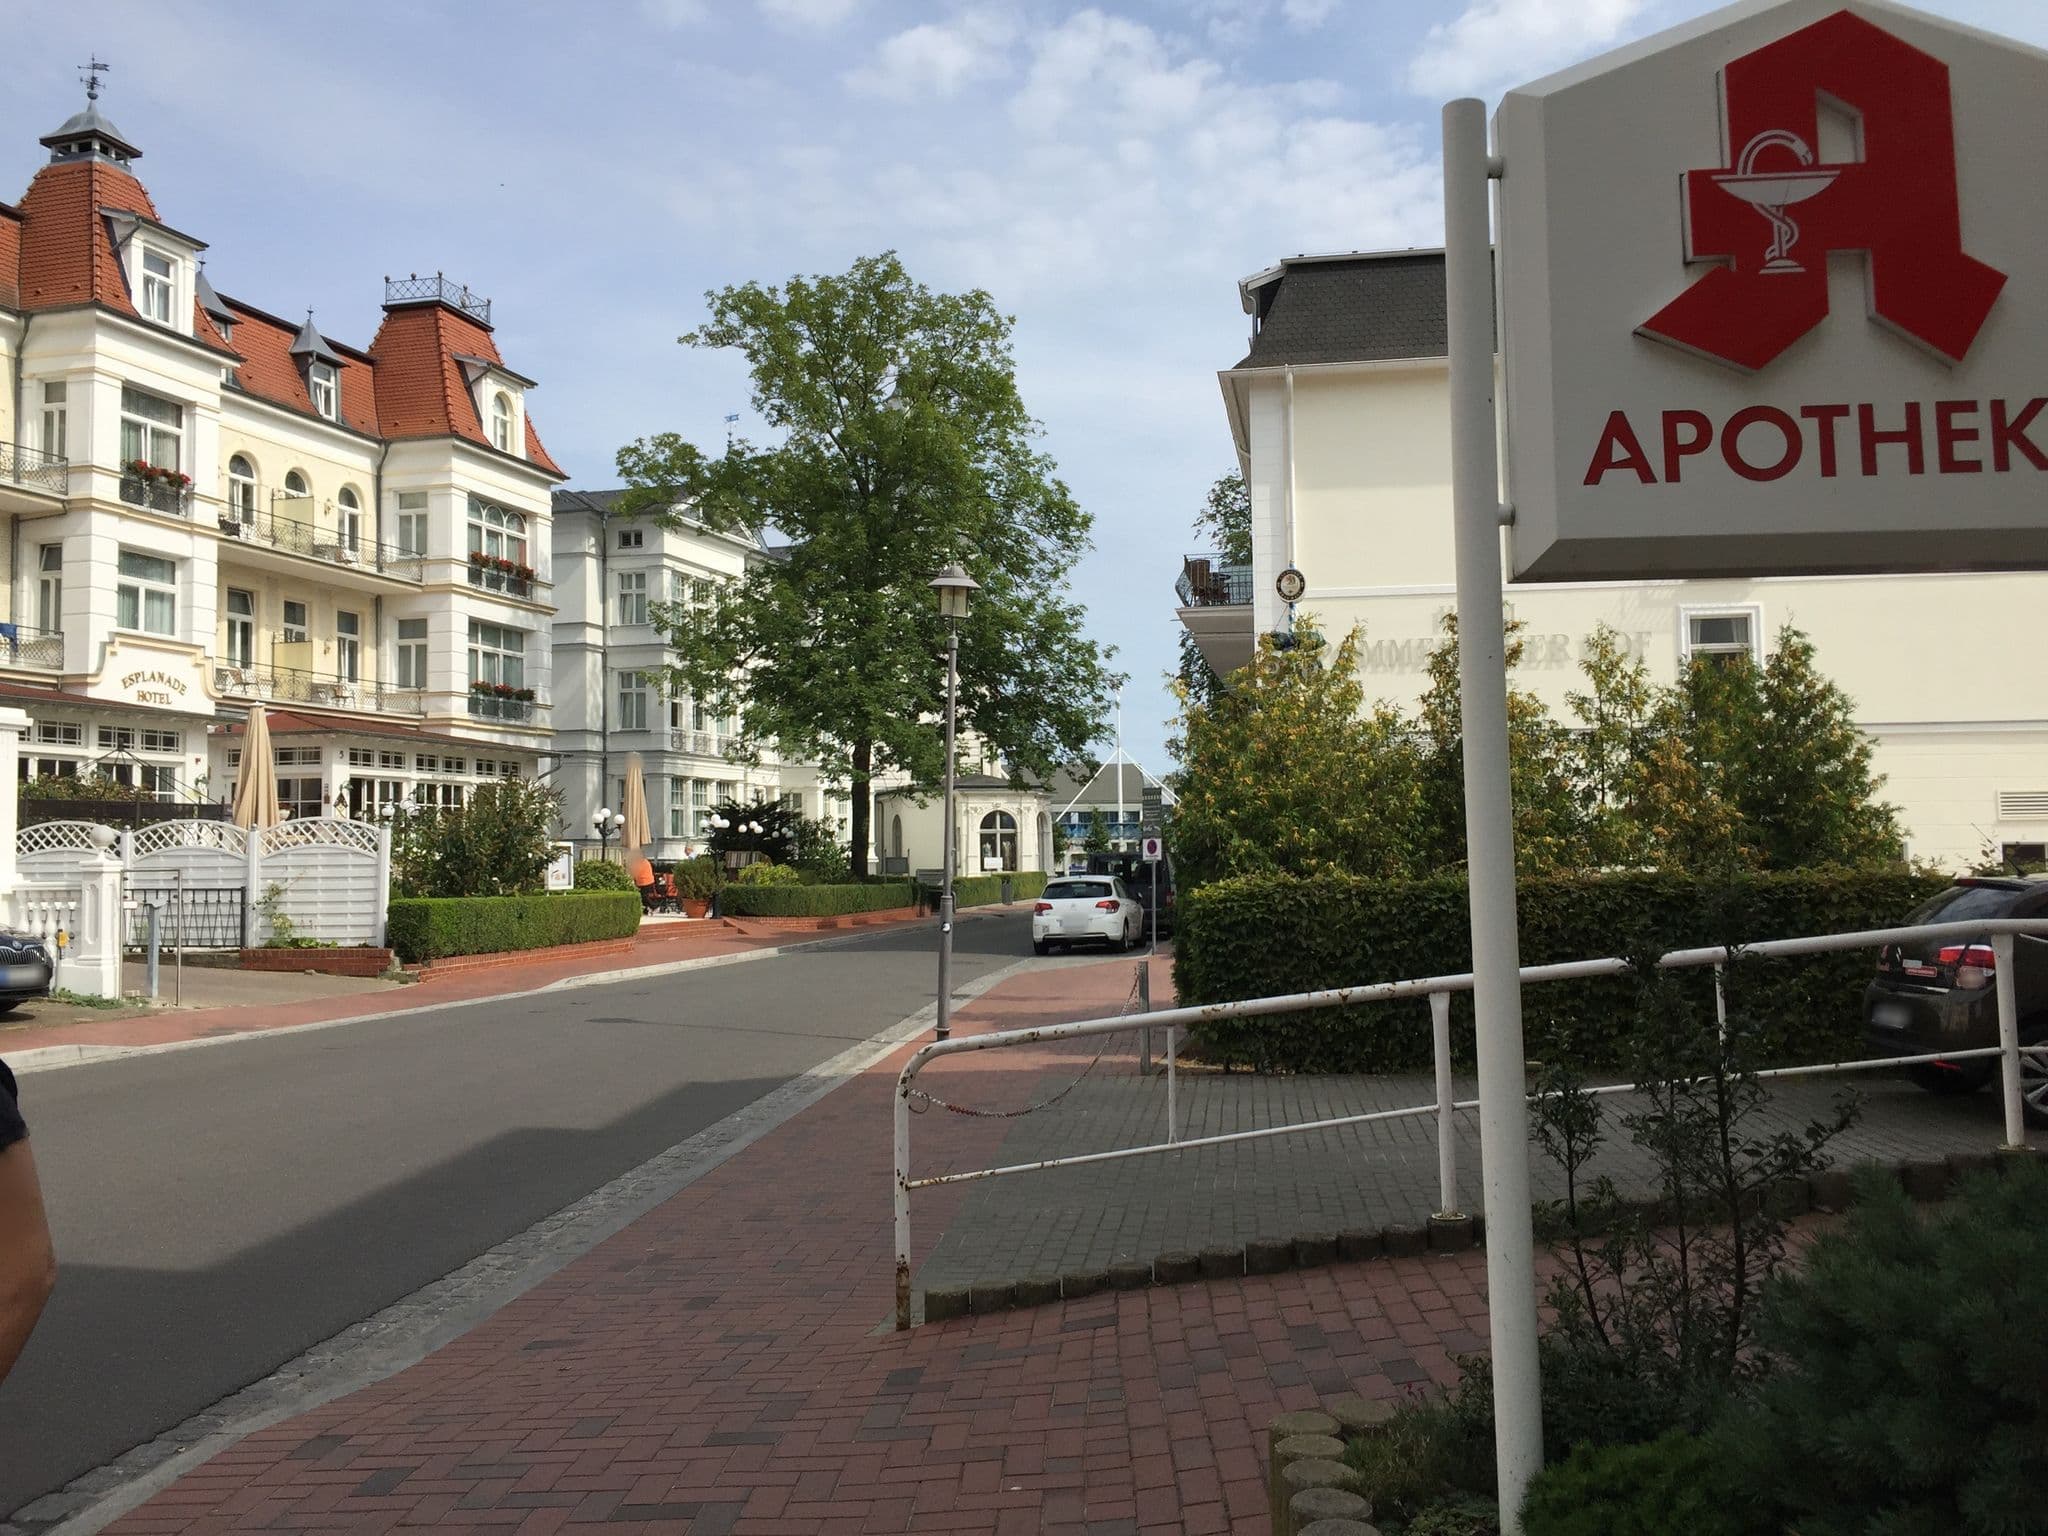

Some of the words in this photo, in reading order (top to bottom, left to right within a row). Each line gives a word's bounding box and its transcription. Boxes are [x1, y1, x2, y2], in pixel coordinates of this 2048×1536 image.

[1583, 397, 2048, 486] APOTHEK
[121, 670, 187, 696] ESPLANADE
[136, 690, 173, 705] HOTEL
